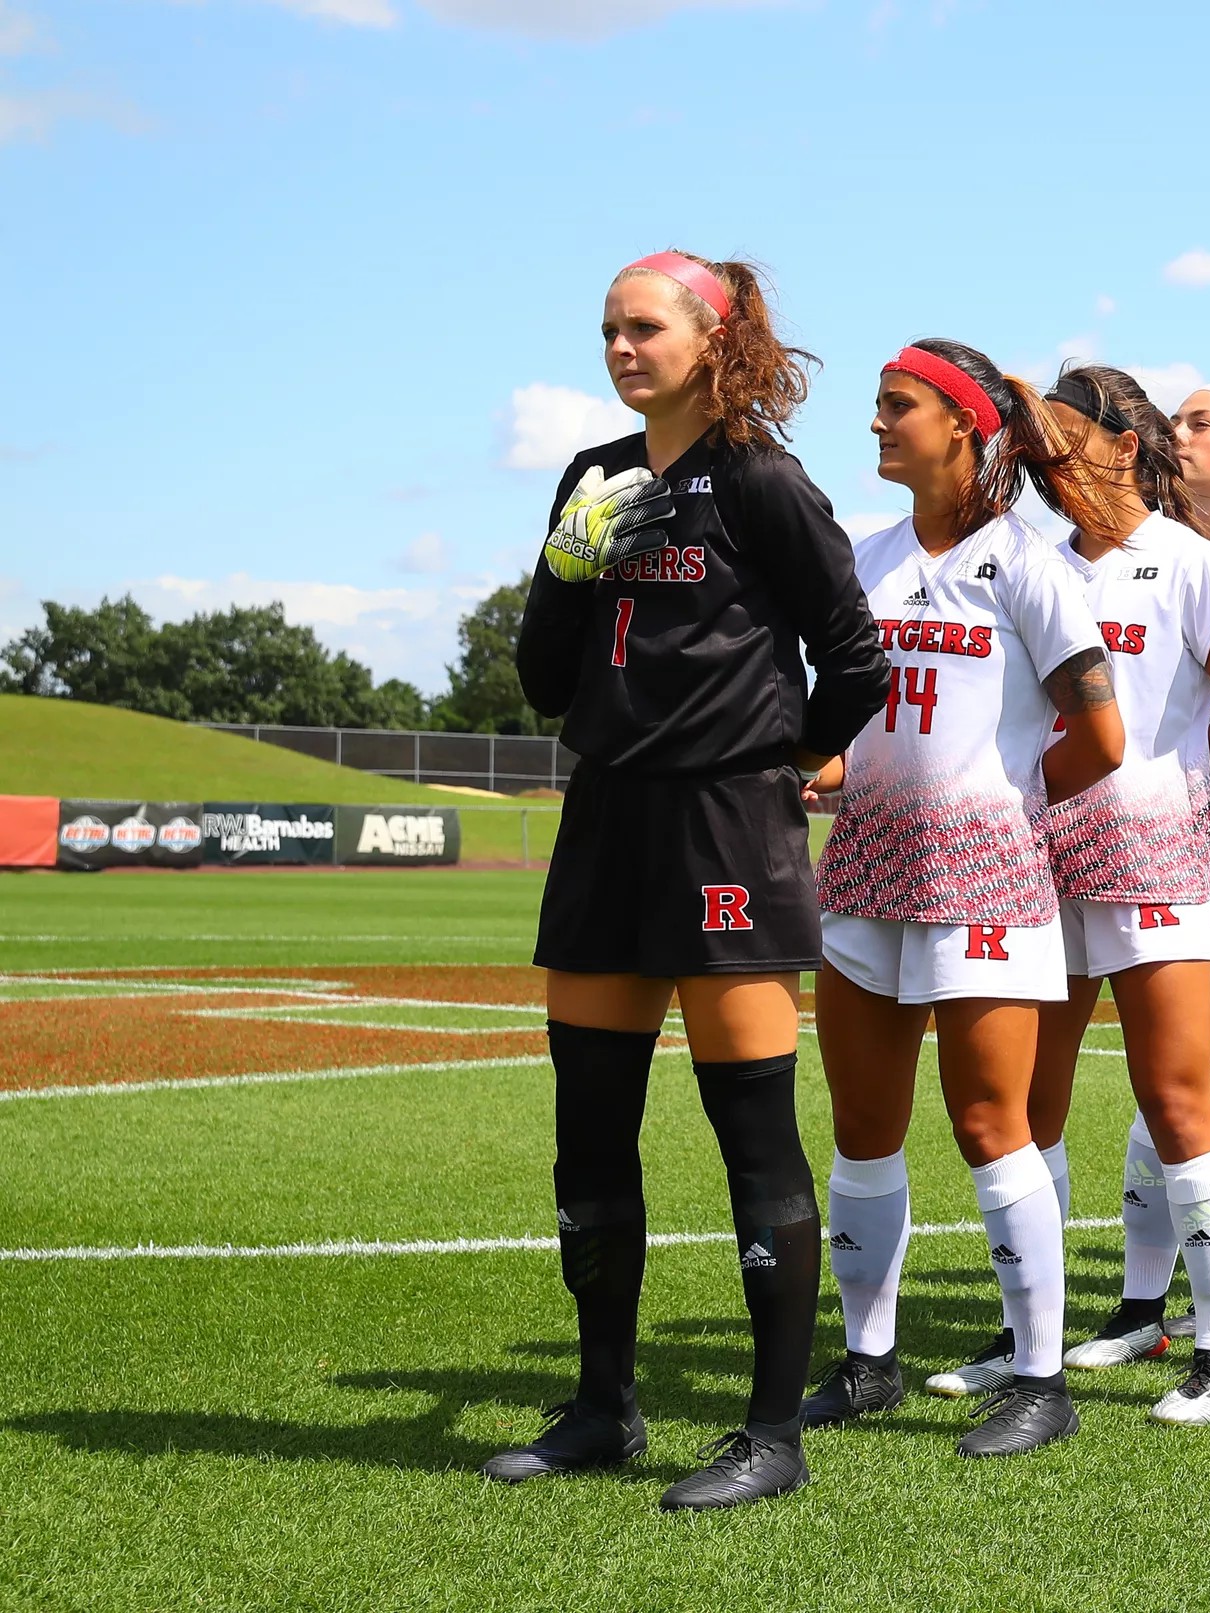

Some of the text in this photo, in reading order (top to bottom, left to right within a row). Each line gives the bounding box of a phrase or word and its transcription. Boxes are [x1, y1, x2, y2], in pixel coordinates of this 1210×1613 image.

[903, 599, 930, 607] adidas
[611, 597, 635, 667] 1
[873, 619, 993, 658] TGERS
[221, 835, 280, 851] HEALTH
[357, 814, 445, 853] ACME
[702, 885, 753, 931] R
[965, 926, 1009, 961] R
